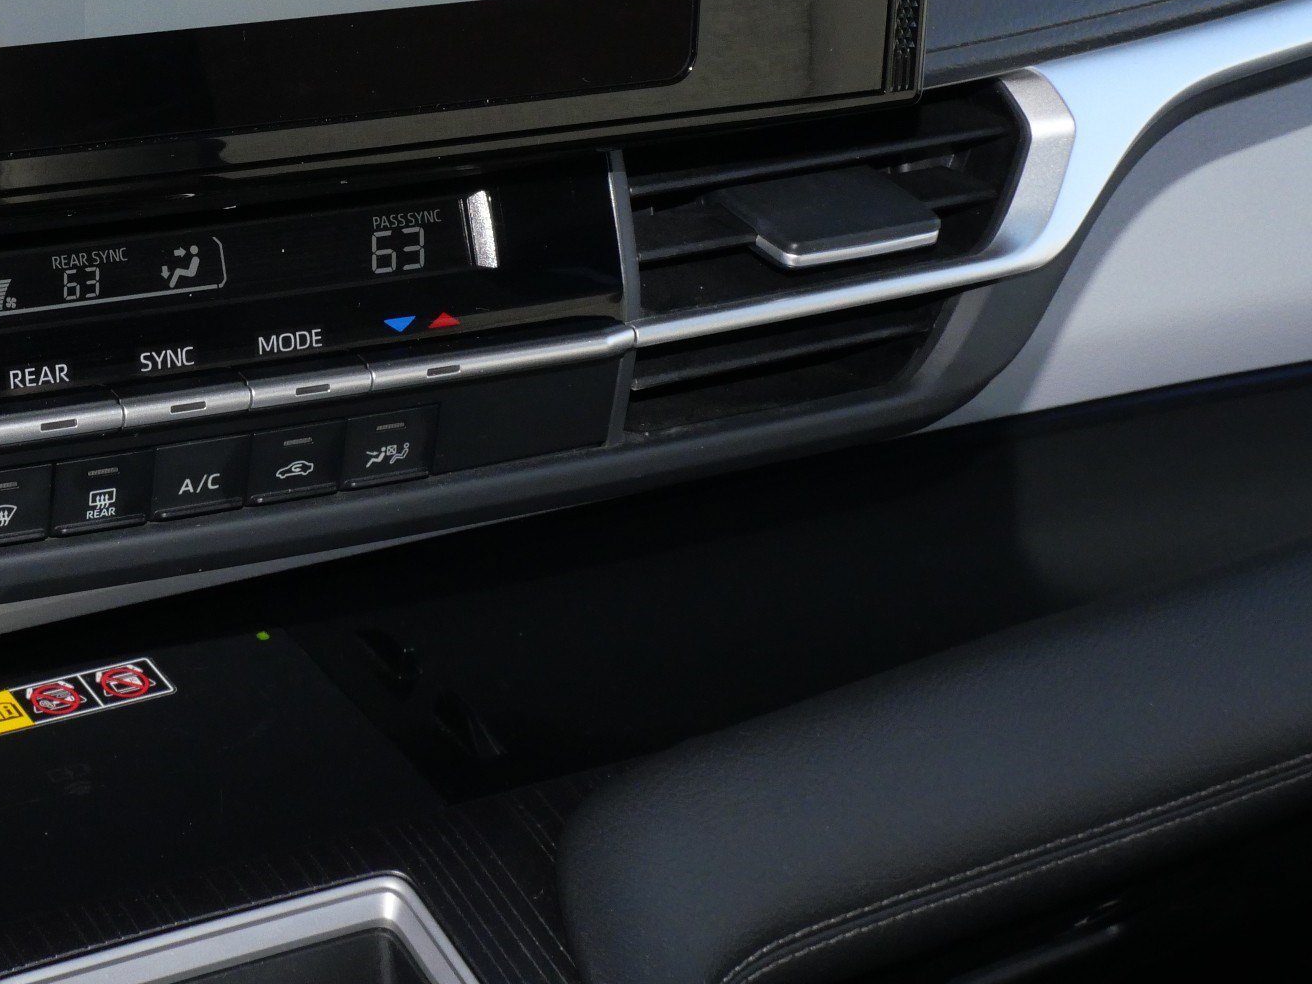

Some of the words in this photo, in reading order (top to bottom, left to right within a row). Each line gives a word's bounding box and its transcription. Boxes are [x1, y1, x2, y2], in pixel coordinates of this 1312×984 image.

[372, 213, 406, 229] PASS
[408, 209, 442, 227] SYNC
[51, 252, 88, 270] REAR
[91, 247, 128, 265] SYNC
[372, 226, 424, 274] 63
[63, 266, 100, 300] 63
[258, 328, 323, 355] MODE
[140, 346, 195, 372] SYNC
[9, 363, 69, 389] REAR
[178, 473, 221, 495] A/C
[86, 507, 116, 520] REAR
